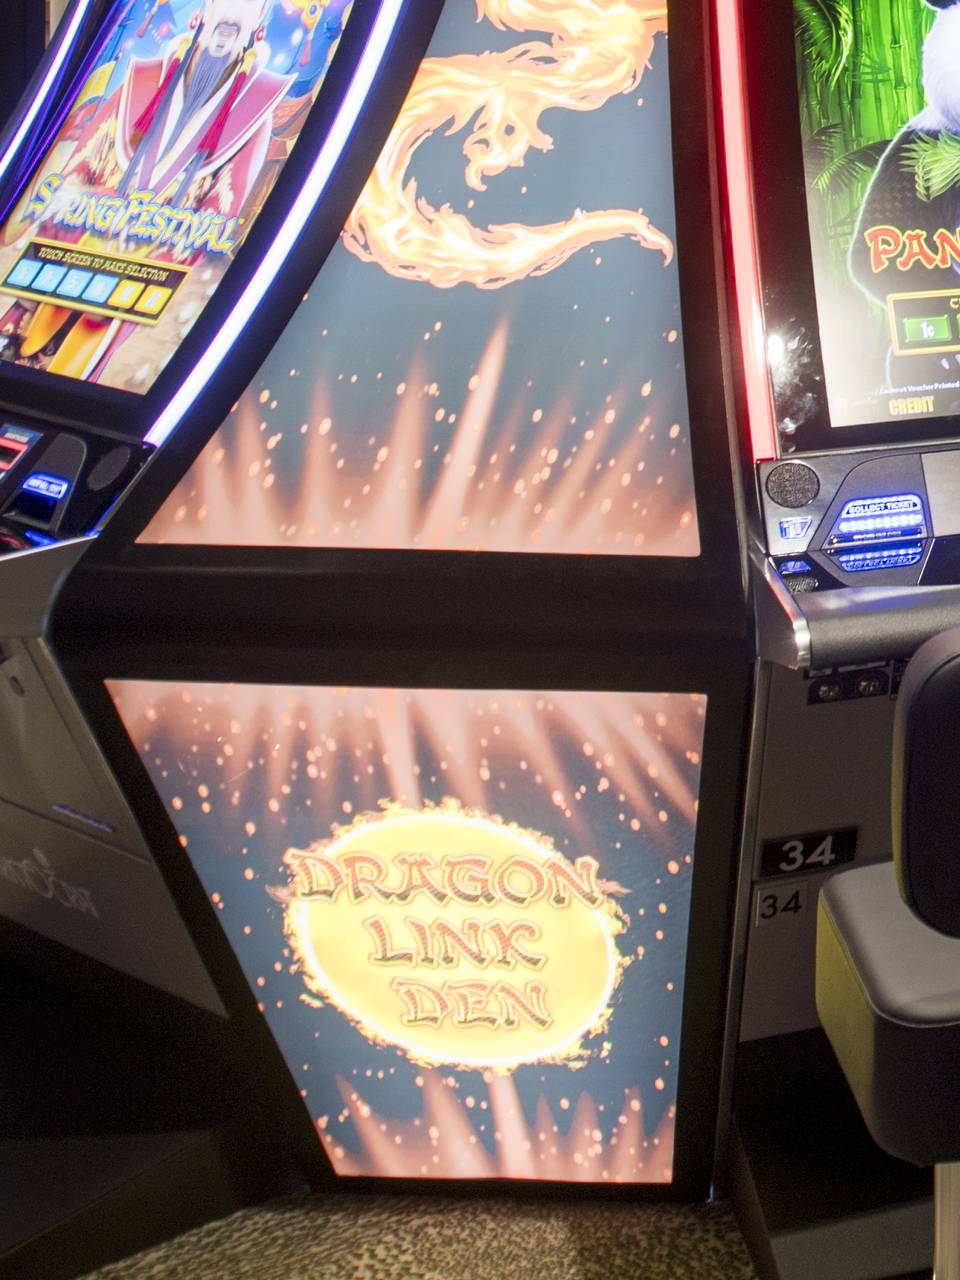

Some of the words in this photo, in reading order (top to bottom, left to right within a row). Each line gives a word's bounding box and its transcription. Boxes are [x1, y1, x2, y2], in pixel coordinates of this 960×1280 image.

[101, 260, 127, 274] MAKE
[125, 265, 169, 281] SELECTION
[889, 396, 934, 415] CREDIT
[849, 502, 885, 514] COLLECT
[885, 500, 914, 511] TICKET
[779, 835, 835, 871] 34
[284, 847, 604, 908] DRAGON
[760, 890, 802, 919] 34
[363, 915, 548, 970] LINK
[392, 976, 554, 1031] DEN
